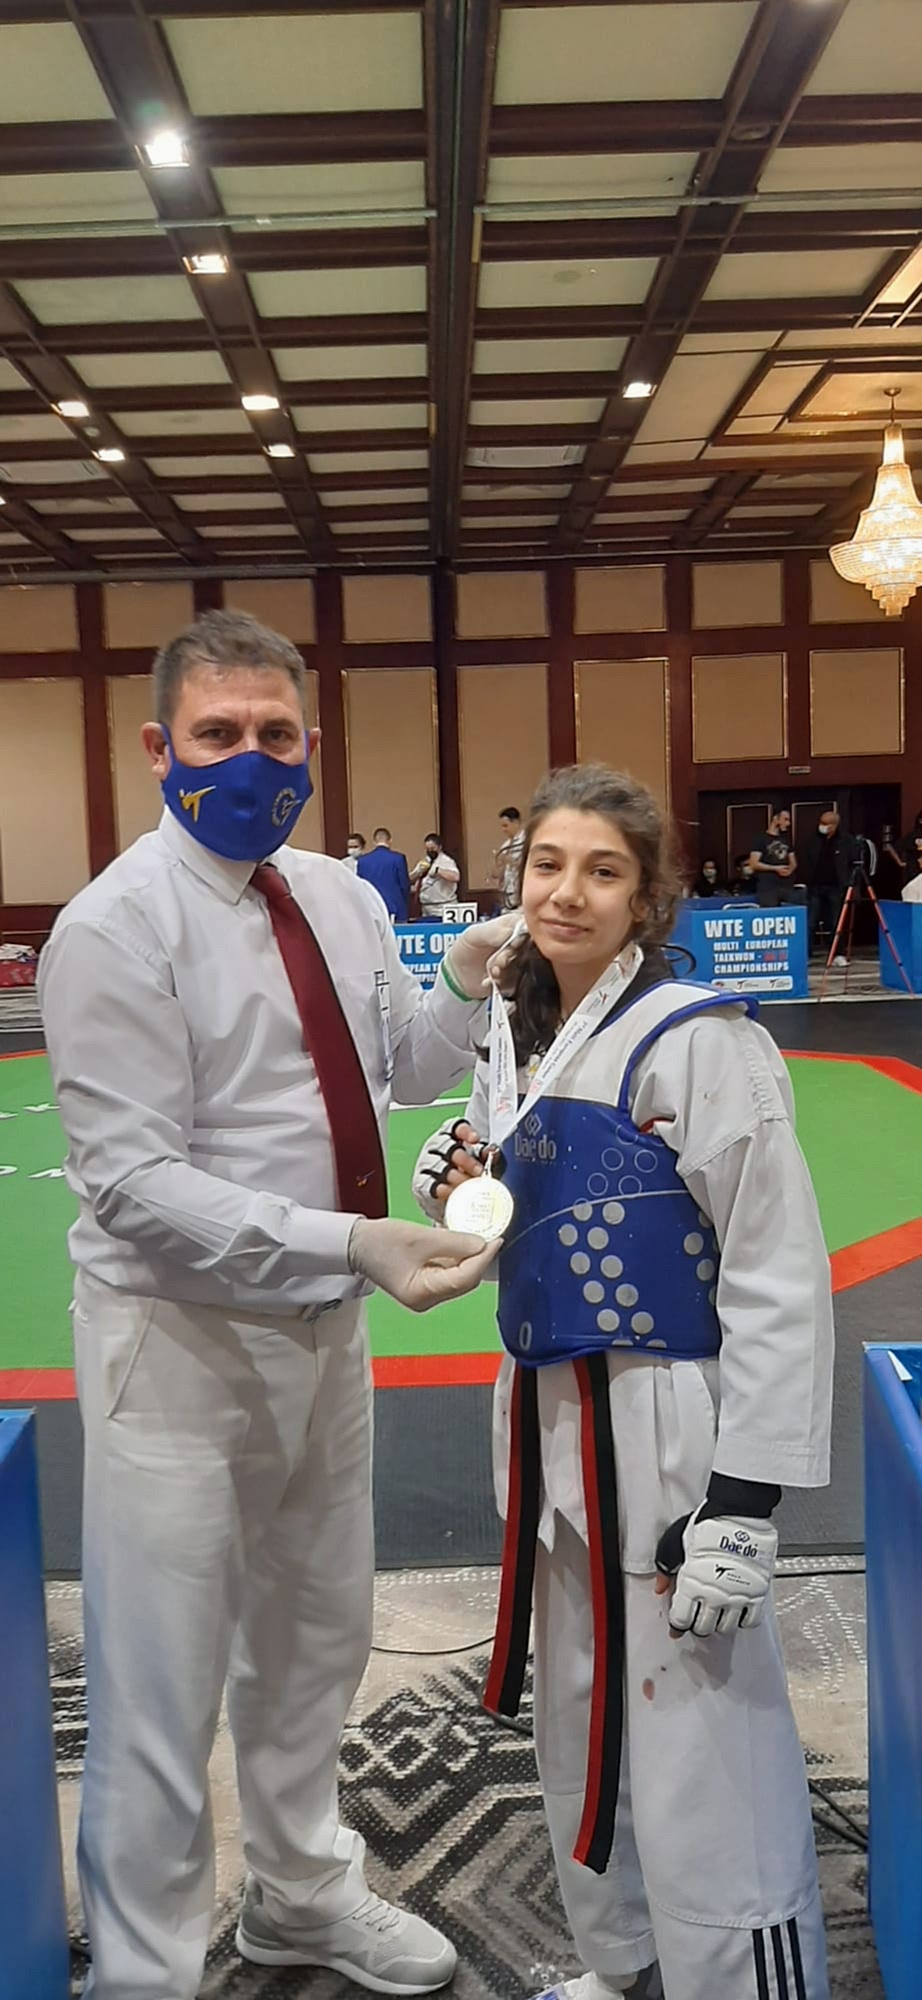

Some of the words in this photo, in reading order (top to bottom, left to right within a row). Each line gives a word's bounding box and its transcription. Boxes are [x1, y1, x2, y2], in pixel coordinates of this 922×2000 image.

[445, 909, 475, 924] 30
[704, 919, 744, 938] WTE
[752, 916, 796, 936] OPEN
[713, 941, 739, 951] MULTI
[745, 939, 788, 950] EUROPEAN
[714, 952, 755, 963] TAEKWON
[714, 962, 789, 974] CHAMPIONSHIPS
